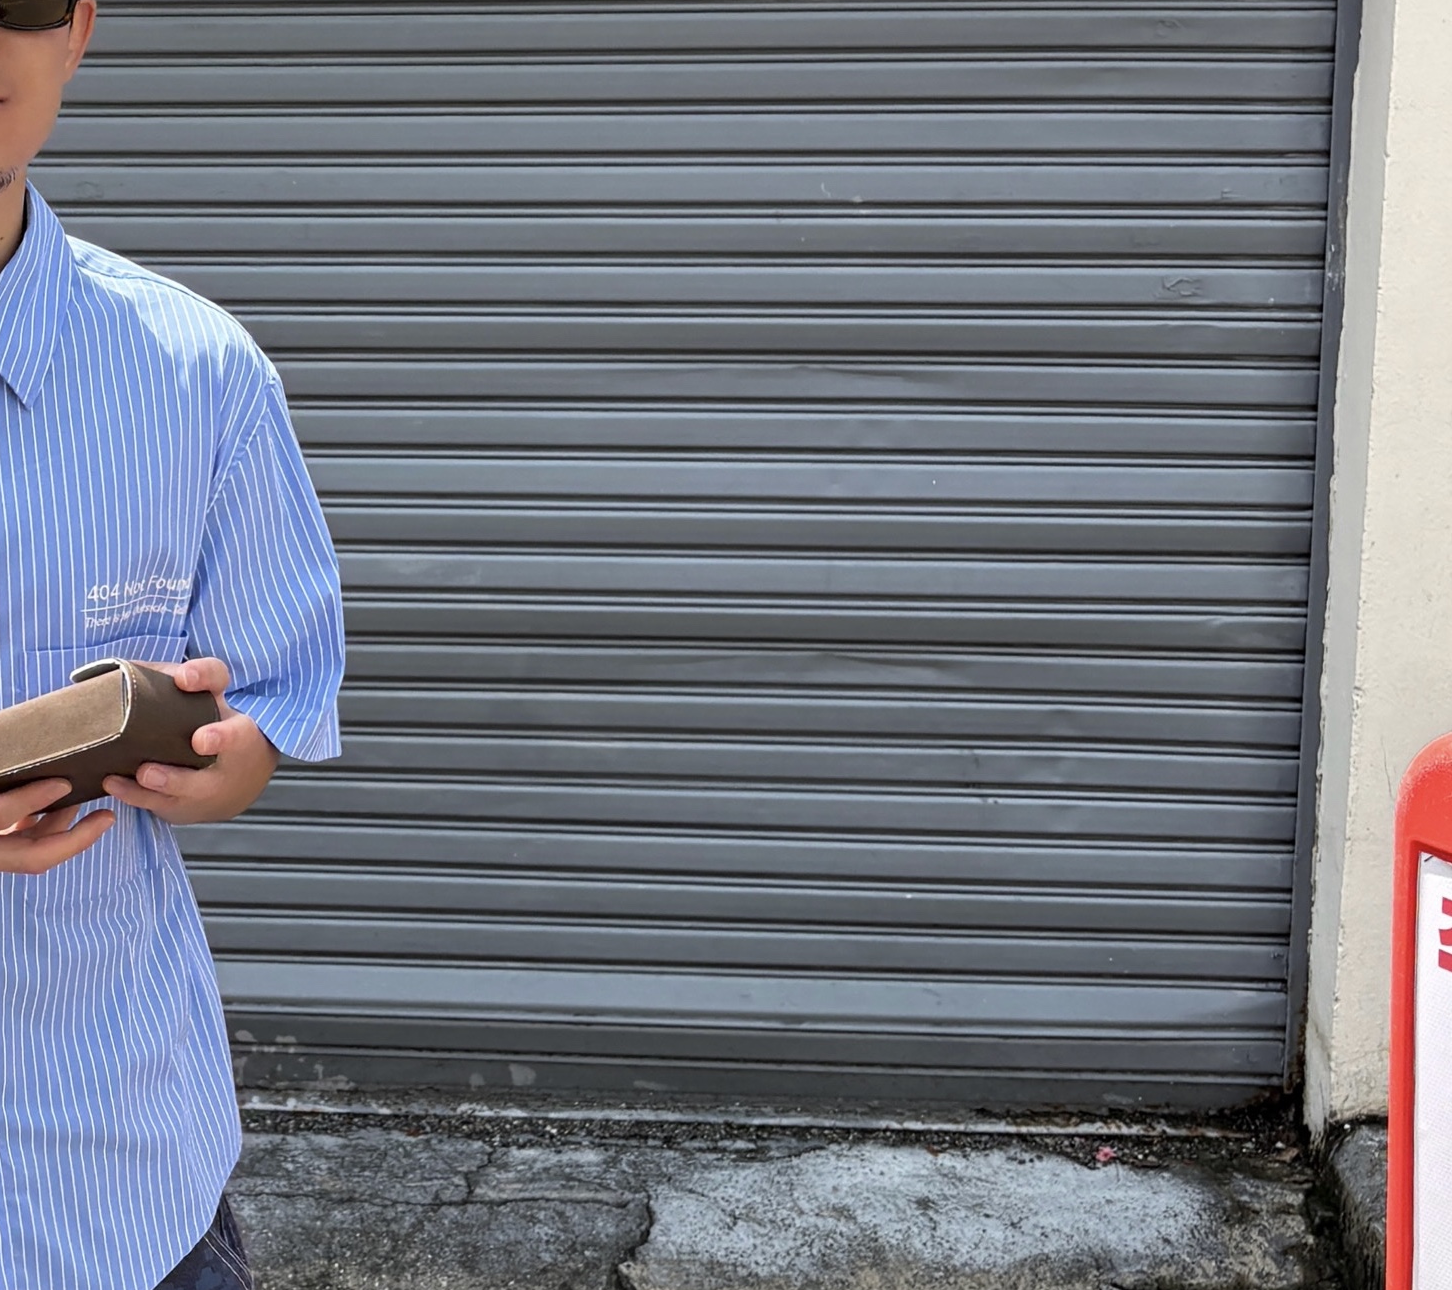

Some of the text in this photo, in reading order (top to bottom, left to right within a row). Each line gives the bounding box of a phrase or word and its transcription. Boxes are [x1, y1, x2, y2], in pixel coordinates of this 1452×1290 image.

[87, 573, 192, 602] 404 Not Found
